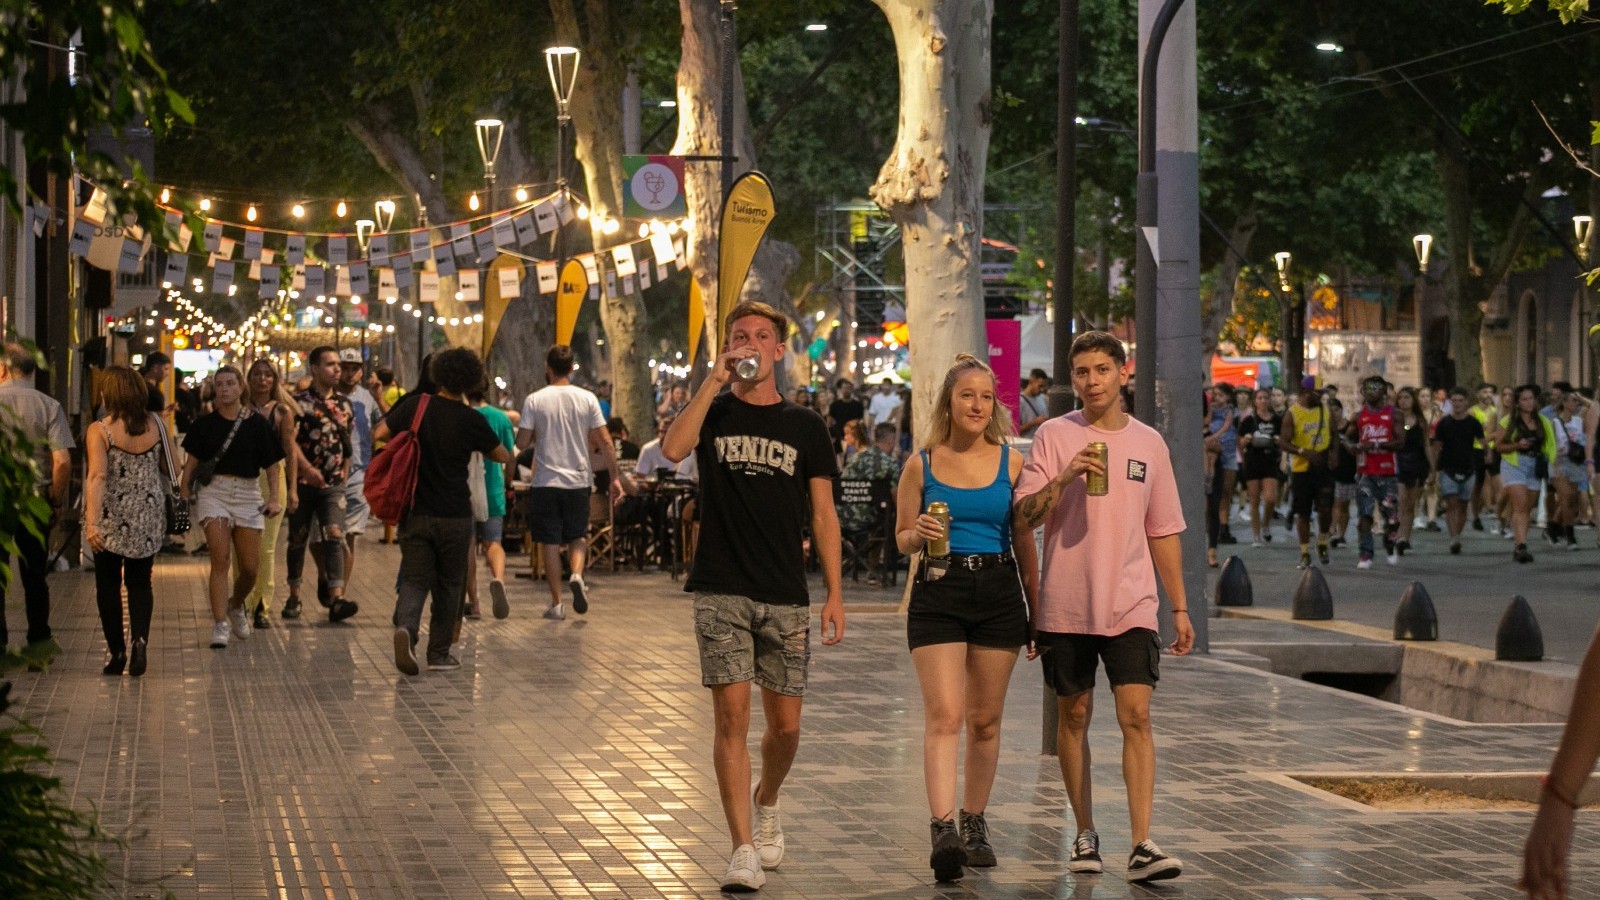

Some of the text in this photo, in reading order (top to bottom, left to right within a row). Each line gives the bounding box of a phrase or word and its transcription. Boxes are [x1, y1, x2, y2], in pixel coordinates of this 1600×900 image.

[733, 201, 768, 217] Turismo
[714, 435, 798, 477] VENICE
[745, 462, 775, 476] Angeles
